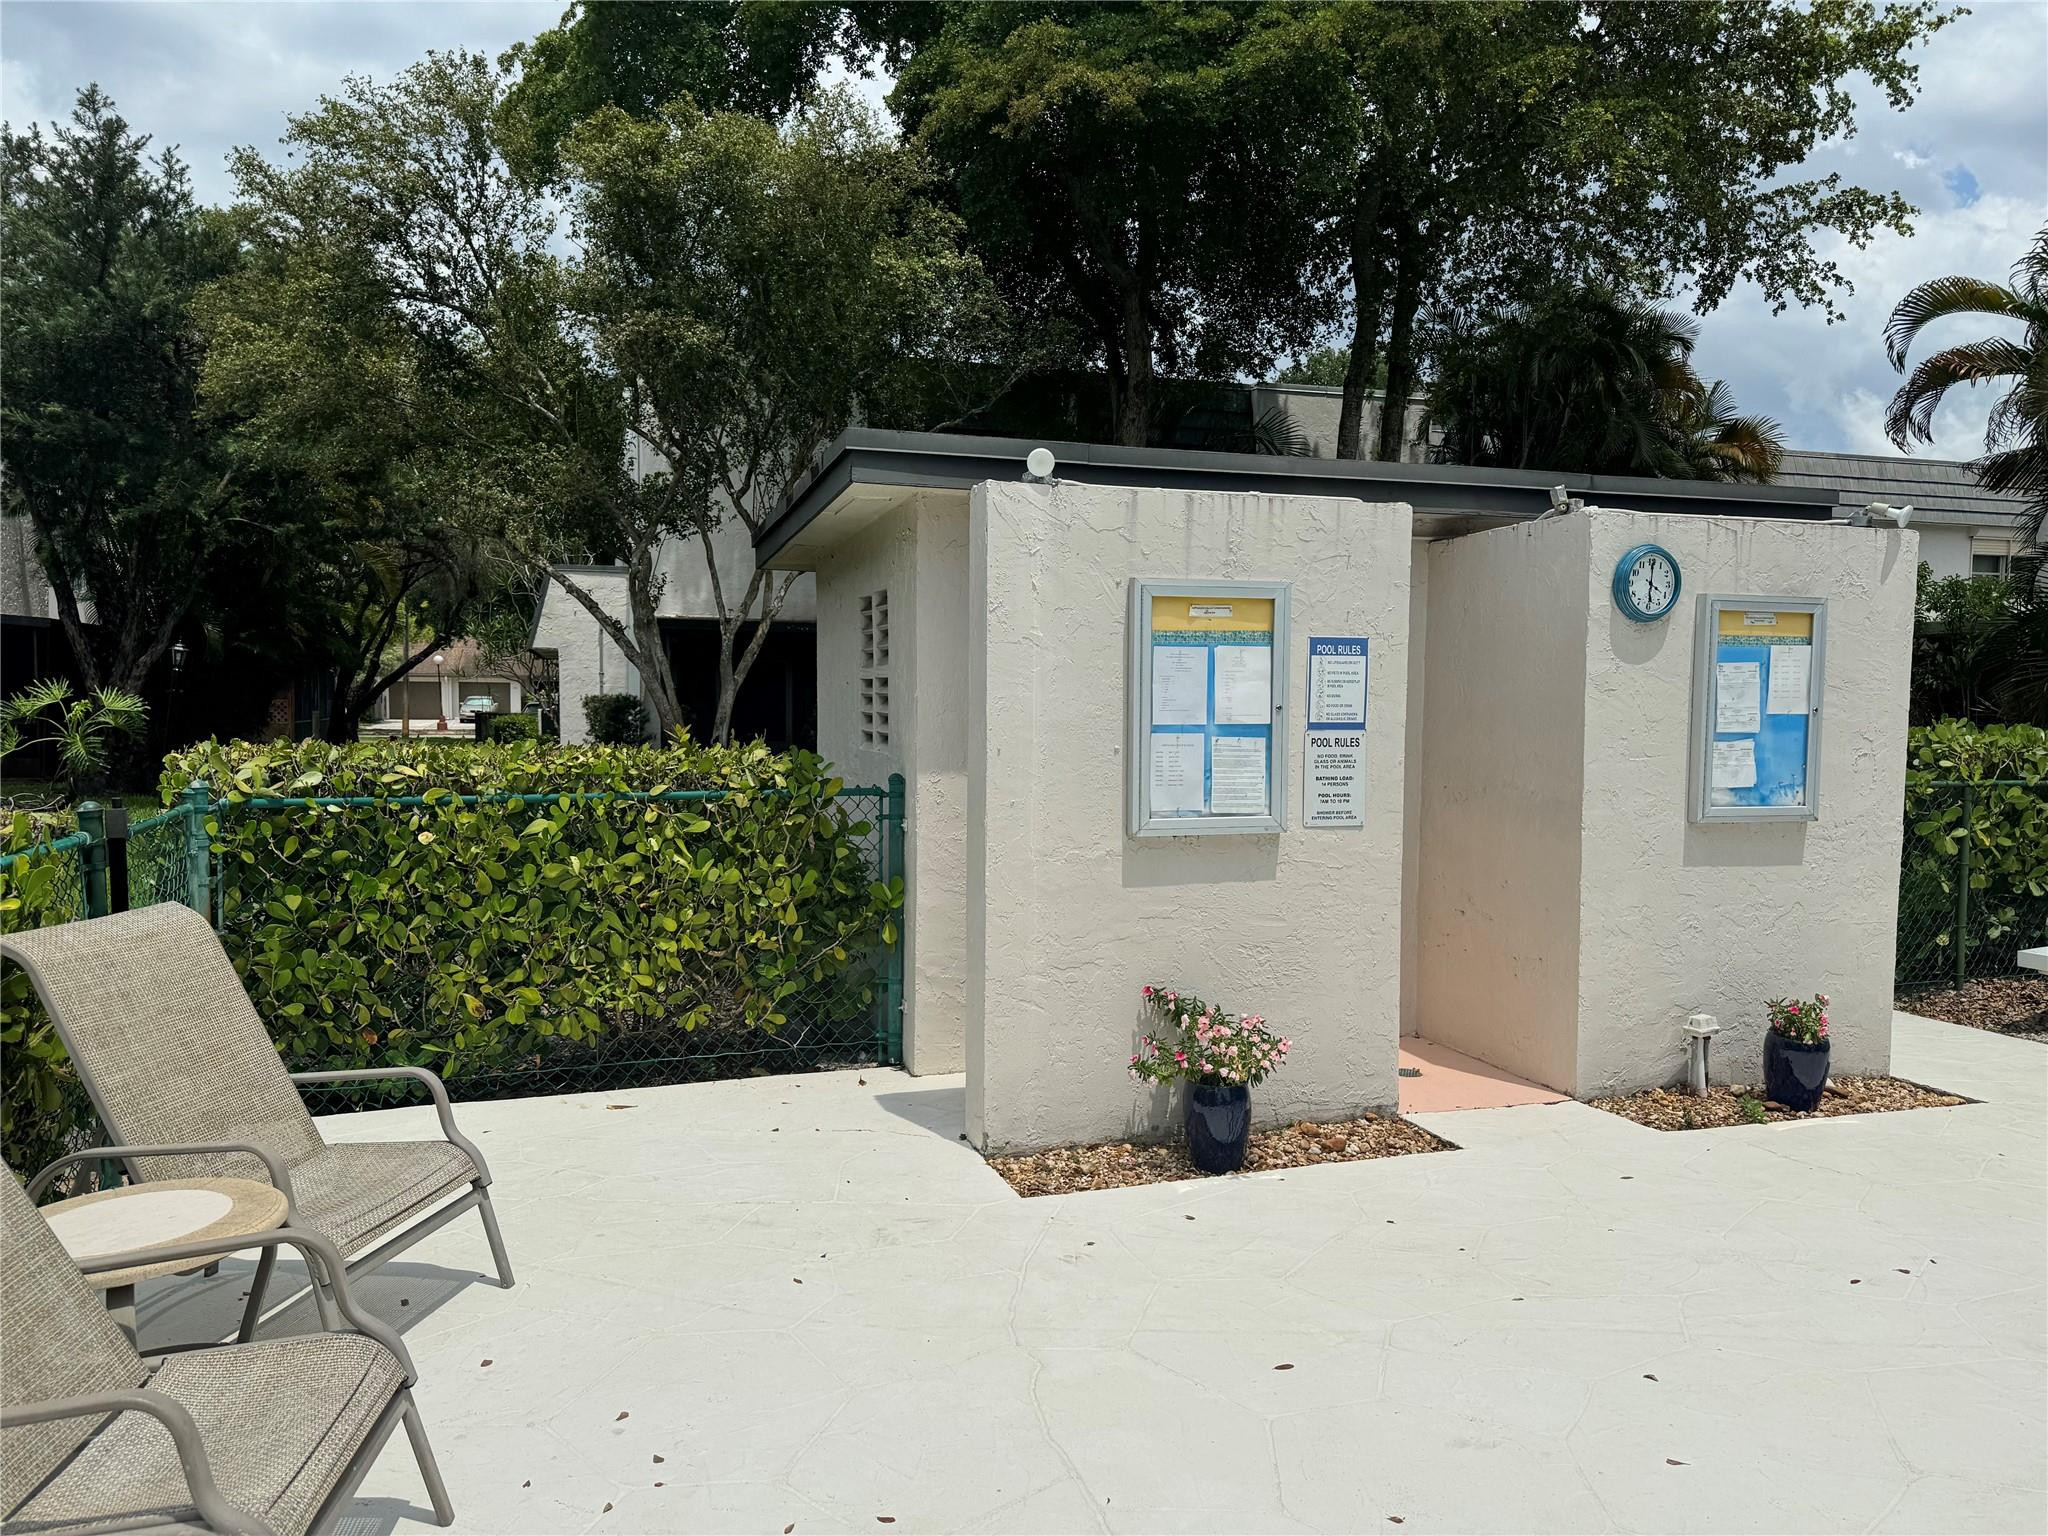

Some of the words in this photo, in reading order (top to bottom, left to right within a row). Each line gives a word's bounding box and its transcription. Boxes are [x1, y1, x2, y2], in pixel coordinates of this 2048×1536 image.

[1637, 598, 1641, 606] 7
[1317, 645, 1336, 654] POOL
[1338, 645, 1361, 654] RULES
[1311, 738, 1332, 747] POOL
[1335, 738, 1360, 747] RULES
